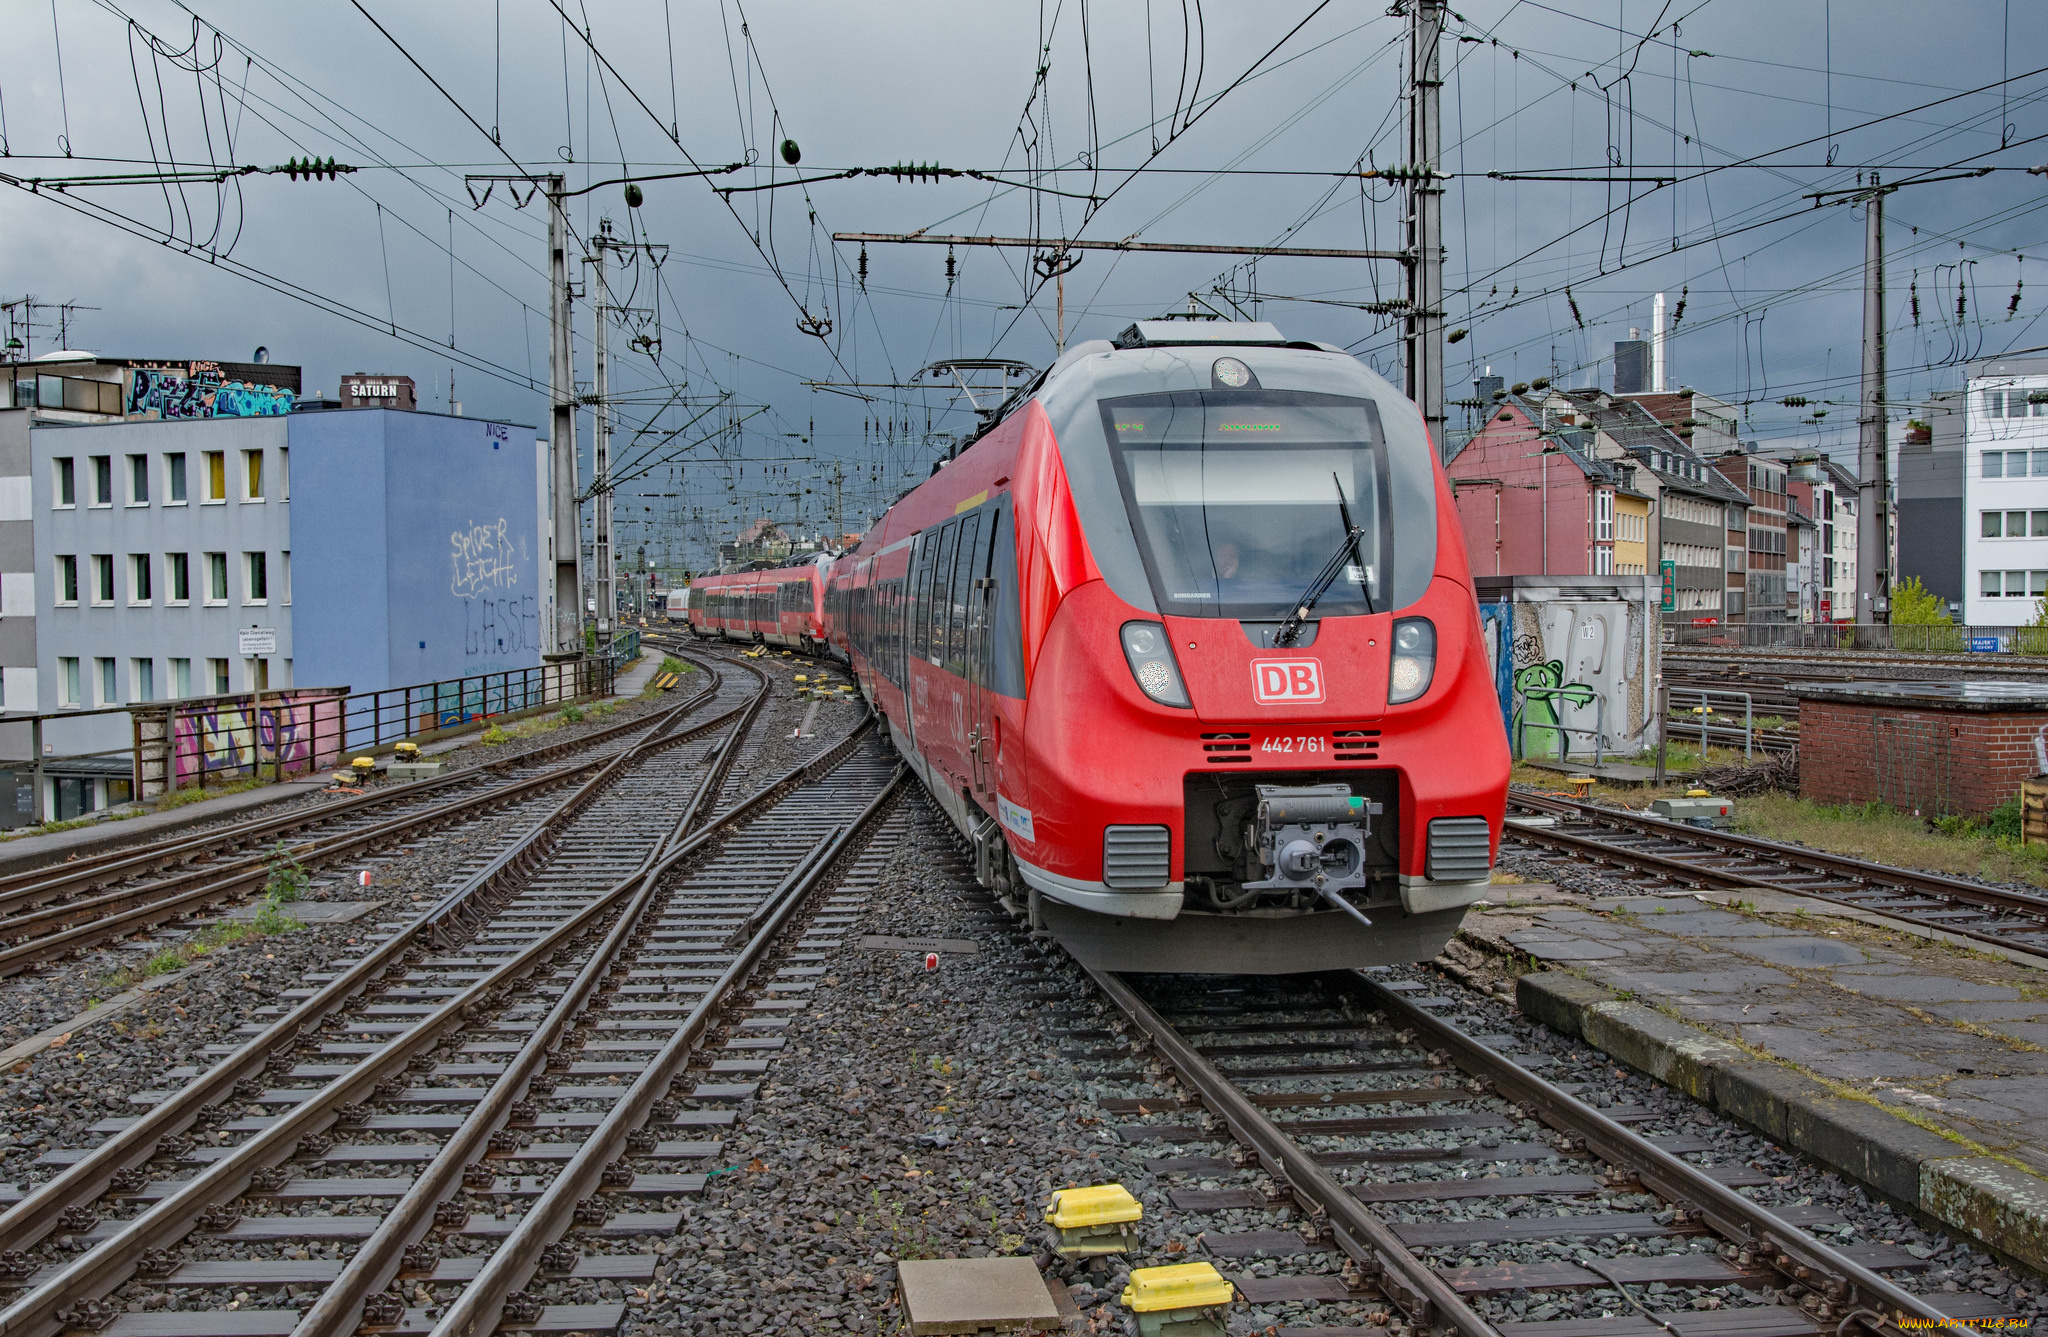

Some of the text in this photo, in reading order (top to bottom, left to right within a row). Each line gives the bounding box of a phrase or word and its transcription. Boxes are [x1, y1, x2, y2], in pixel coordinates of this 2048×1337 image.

[351, 385, 397, 397] SATURN
[486, 423, 508, 440] NICE
[1582, 626, 1594, 638] W 2
[1260, 665, 1316, 697] DB
[1261, 736, 1325, 753] 442 761
